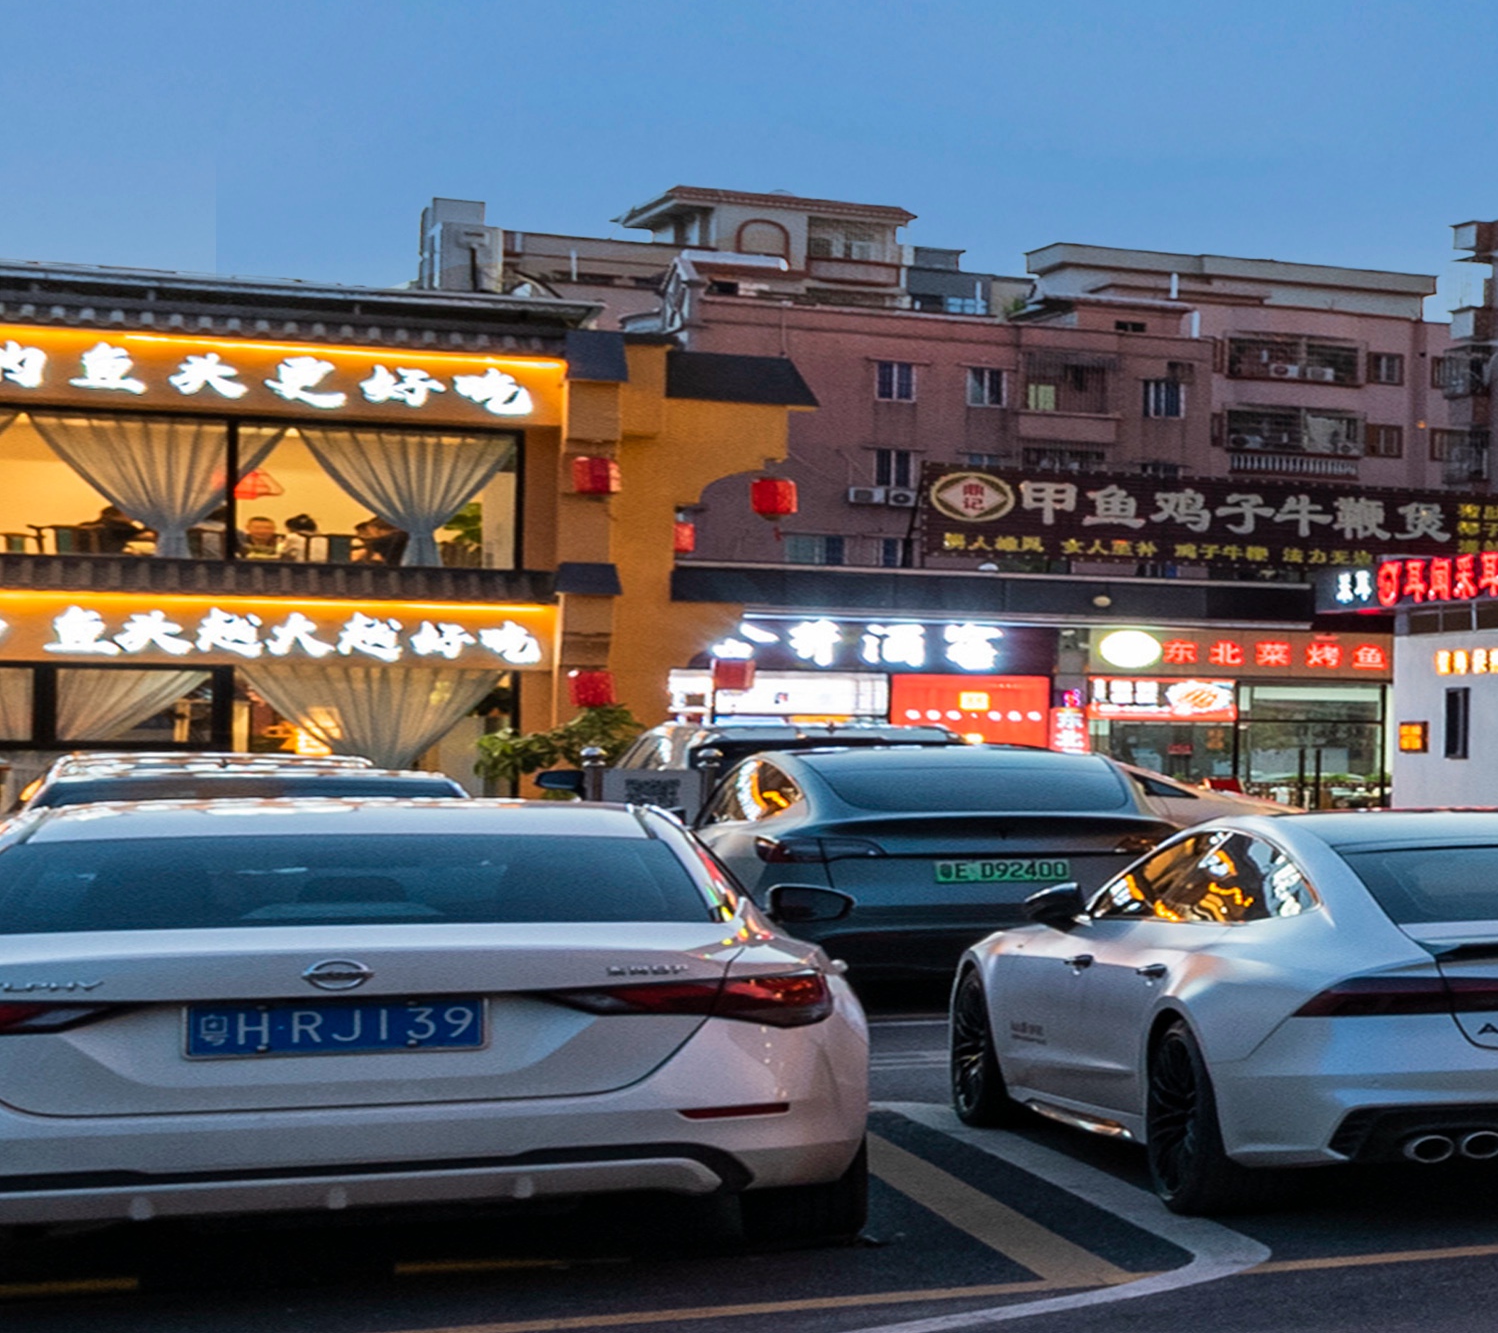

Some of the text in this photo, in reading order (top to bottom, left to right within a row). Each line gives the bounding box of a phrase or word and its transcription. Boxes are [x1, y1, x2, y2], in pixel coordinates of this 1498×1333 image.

[1161, 638, 1390, 671] 东北菜烤鱼
